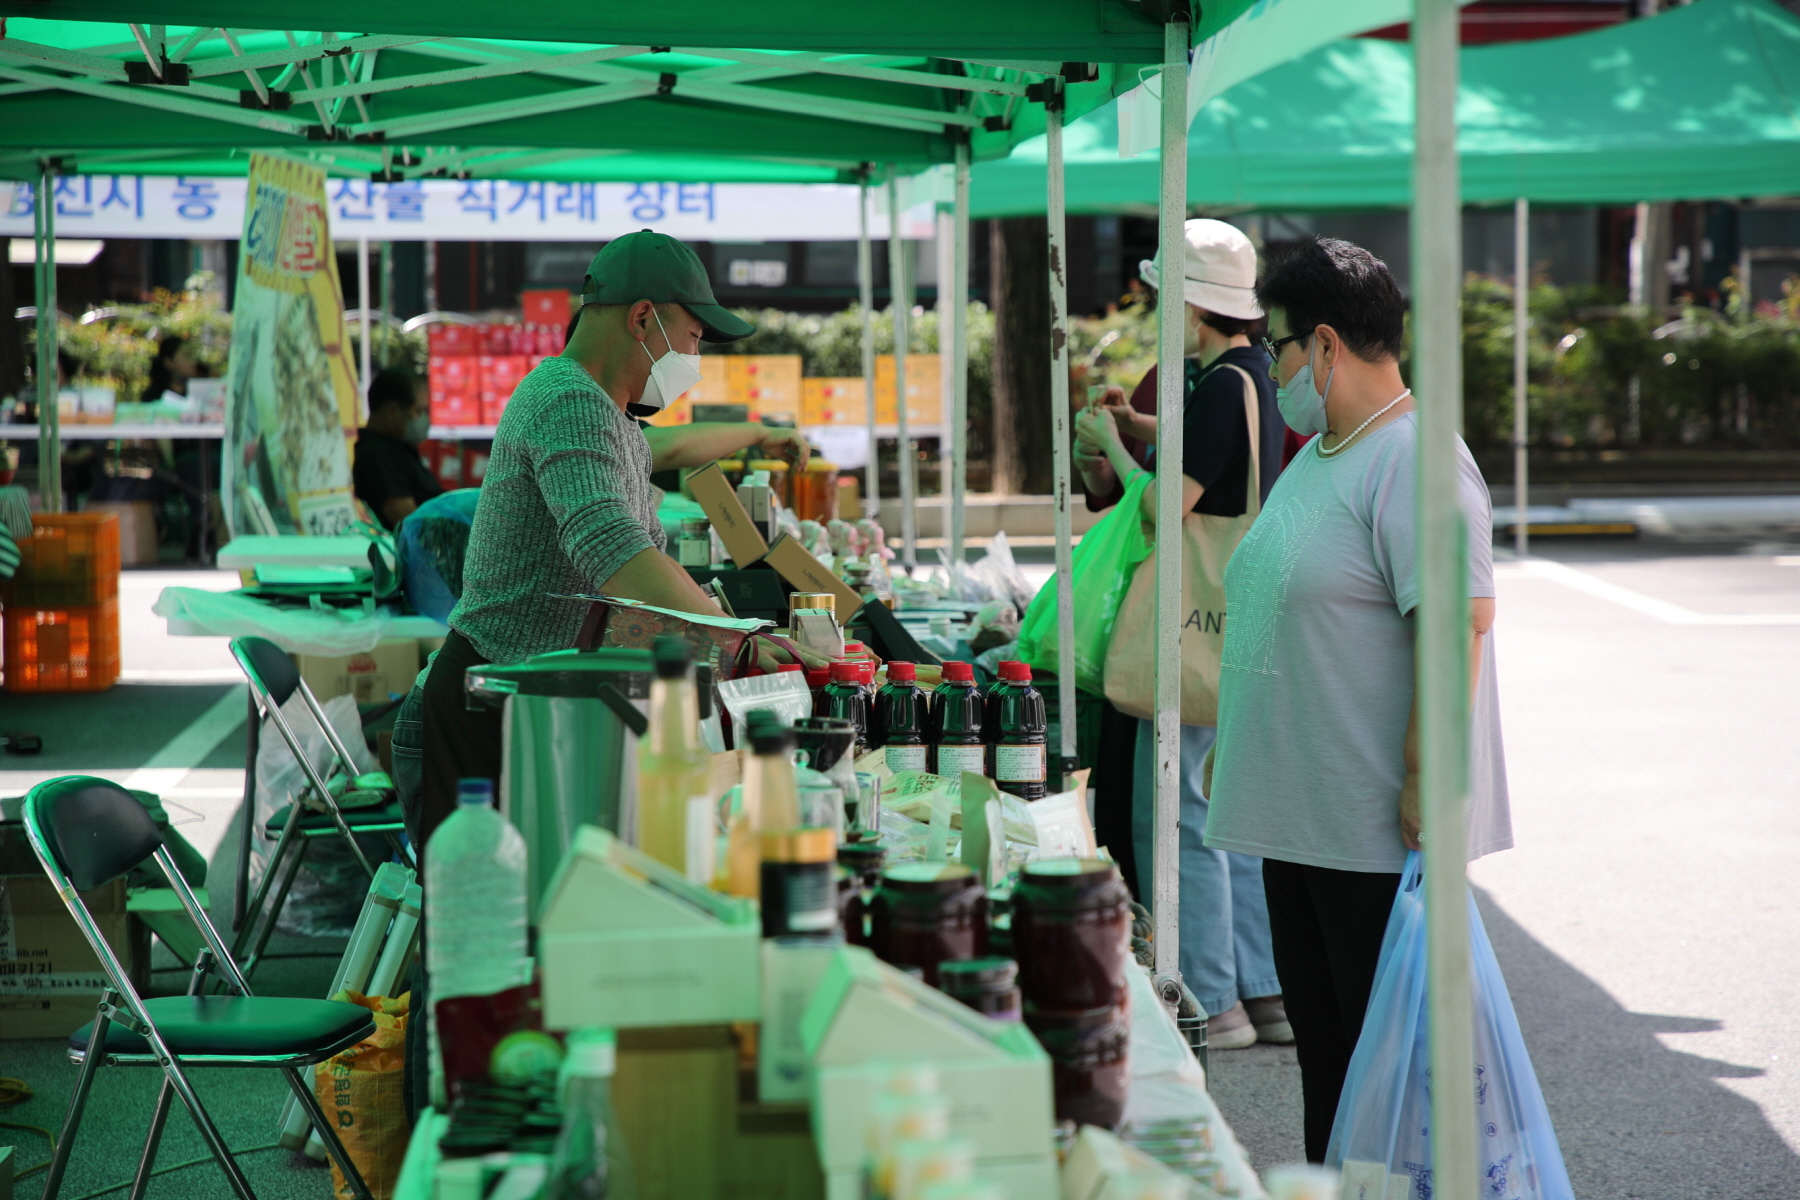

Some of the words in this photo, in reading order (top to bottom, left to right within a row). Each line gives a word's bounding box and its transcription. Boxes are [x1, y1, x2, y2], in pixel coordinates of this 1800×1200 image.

[457, 180, 598, 222] 직거래
[626, 182, 714, 222] 장터
[1181, 608, 1227, 635] AN
